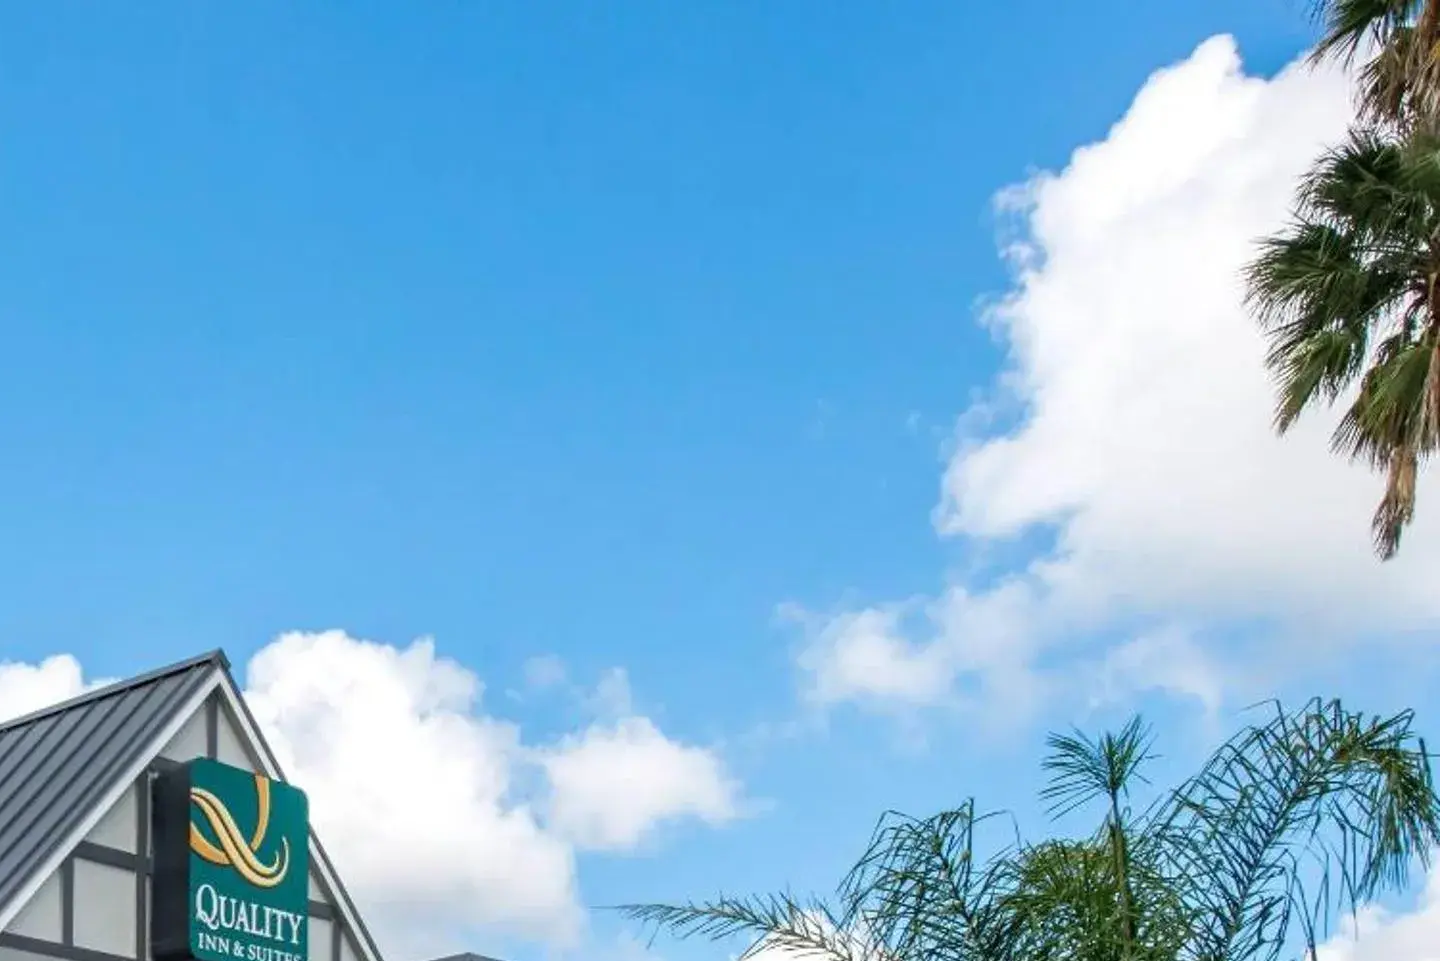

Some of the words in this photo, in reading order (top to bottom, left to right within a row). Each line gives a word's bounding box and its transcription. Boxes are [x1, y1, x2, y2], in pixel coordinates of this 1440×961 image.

[195, 884, 304, 945] QUALITY
[198, 932, 230, 956] INN
[233, 940, 245, 958] &
